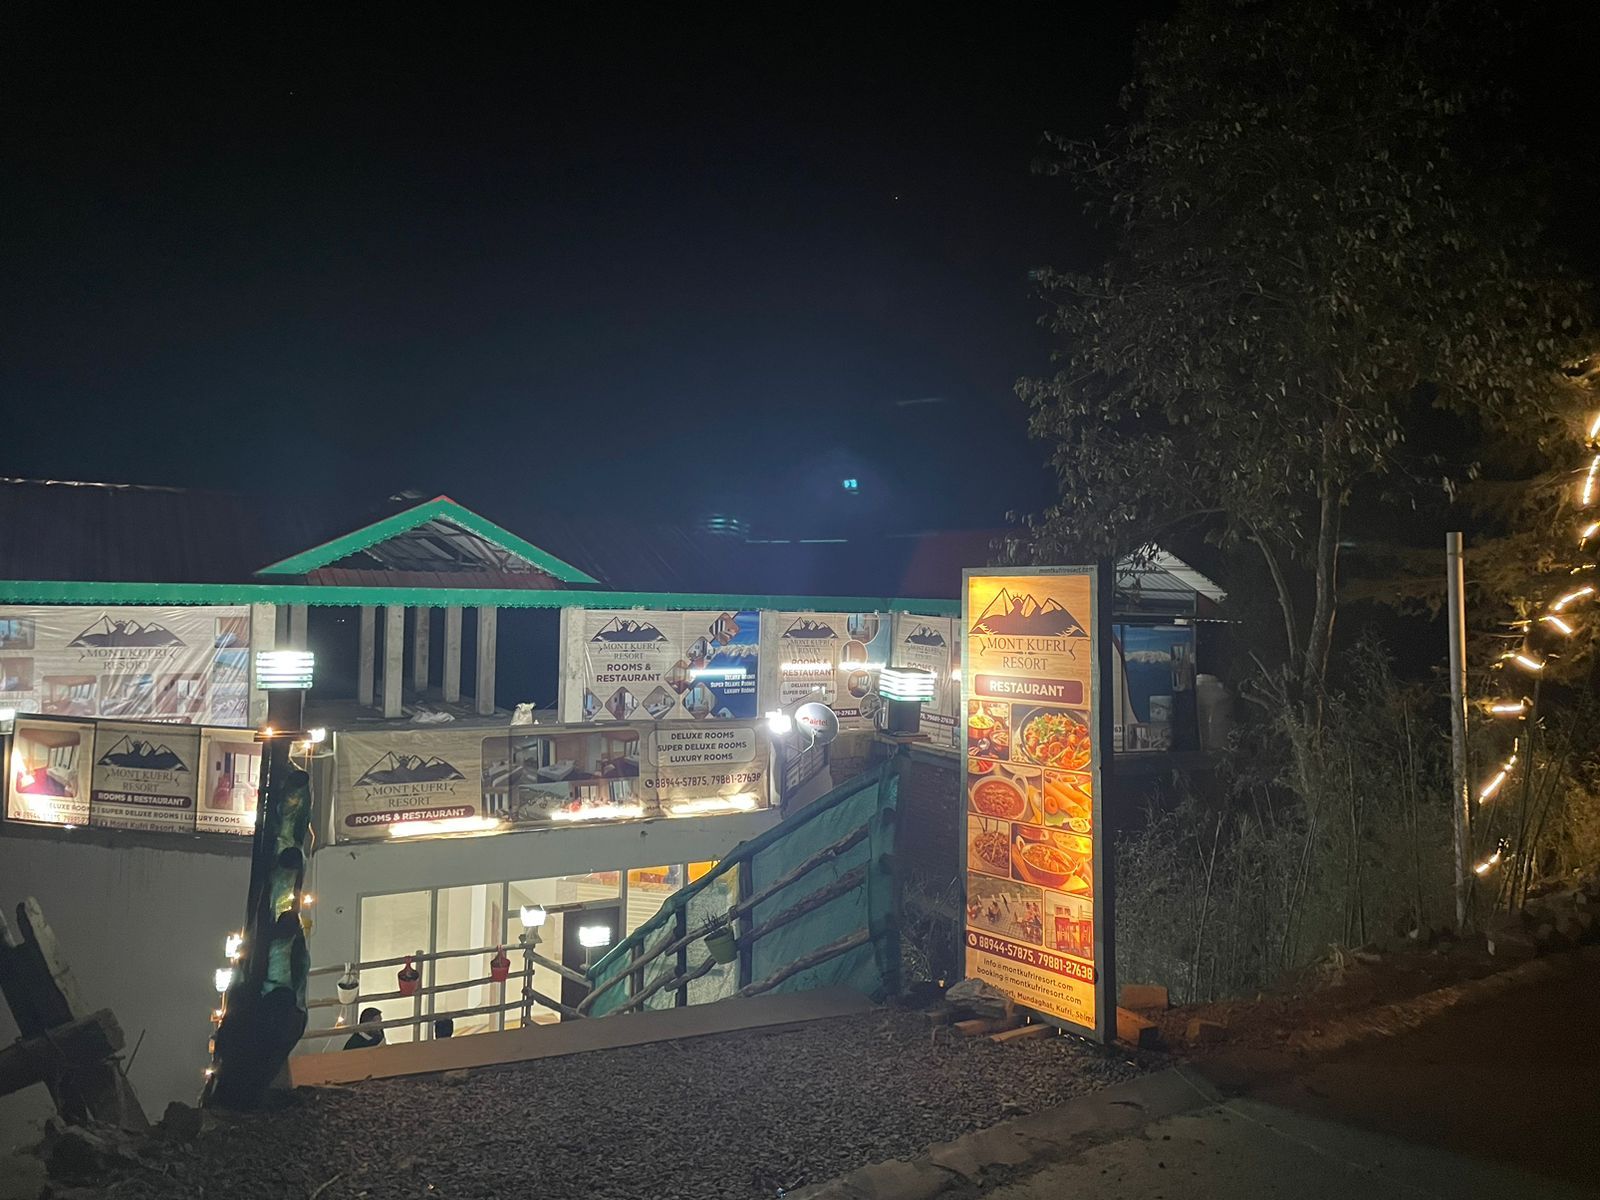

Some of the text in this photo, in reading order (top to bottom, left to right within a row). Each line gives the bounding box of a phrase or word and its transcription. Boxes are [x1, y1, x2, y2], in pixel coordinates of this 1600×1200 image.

[987, 637, 1066, 652] MONT KUFRI
[87, 648, 167, 657] MONT KUFRI
[607, 663, 651, 671] ROOMS &
[1002, 657, 1048, 670] RESORT
[596, 673, 661, 683] RESTAURANT
[783, 669, 836, 677] RESTAURANT
[989, 681, 1065, 697] RESTAURANT
[671, 731, 735, 740] DELUXE ROOMS
[657, 741, 747, 752] SUPER DELUXE ROOMS
[670, 753, 734, 763] LUXURY ROOMS
[110, 768, 173, 781] MONT KUFRI
[122, 782, 159, 792] RESORT
[655, 776, 709, 789] 88944-57875,
[373, 783, 449, 796] MONT KUFRI
[98, 792, 126, 802] ROOMS
[133, 795, 185, 806] RESTAURANT
[388, 796, 432, 808] RESORT
[102, 807, 123, 816] SUPER
[125, 809, 152, 818] DELUXE
[153, 811, 179, 820] ROOMS
[214, 816, 240, 824] ROOMS
[355, 808, 465, 824] ROOMS & RESTAURANT
[979, 935, 1093, 980] 88944-57875, 79881-27638
[1017, 991, 1055, 1011] Mundaghat,
[1056, 1005, 1075, 1017] Kufri,
